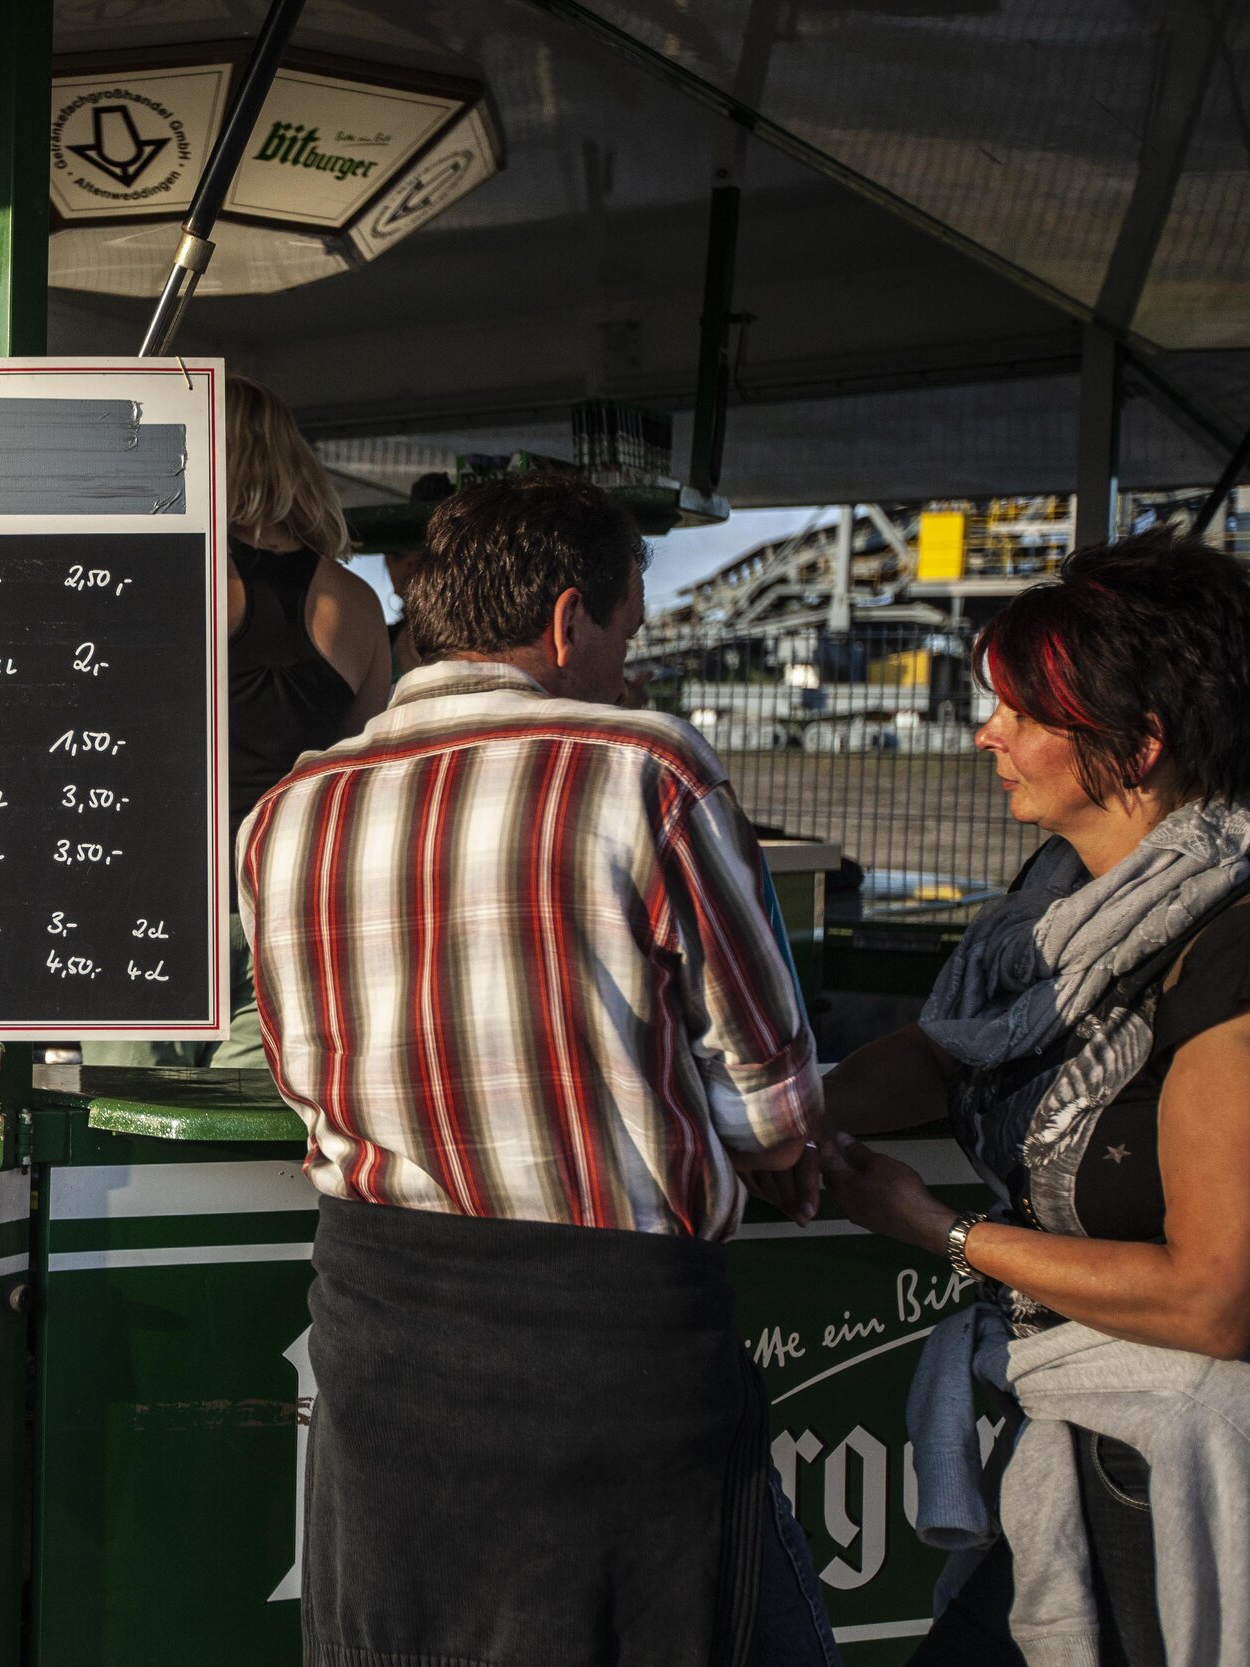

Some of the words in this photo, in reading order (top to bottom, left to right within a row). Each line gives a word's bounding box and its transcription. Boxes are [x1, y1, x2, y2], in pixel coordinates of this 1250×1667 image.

[745, 1325, 806, 1369] tte
[821, 1310, 885, 1348] ein
[896, 1268, 980, 1323] Bit
